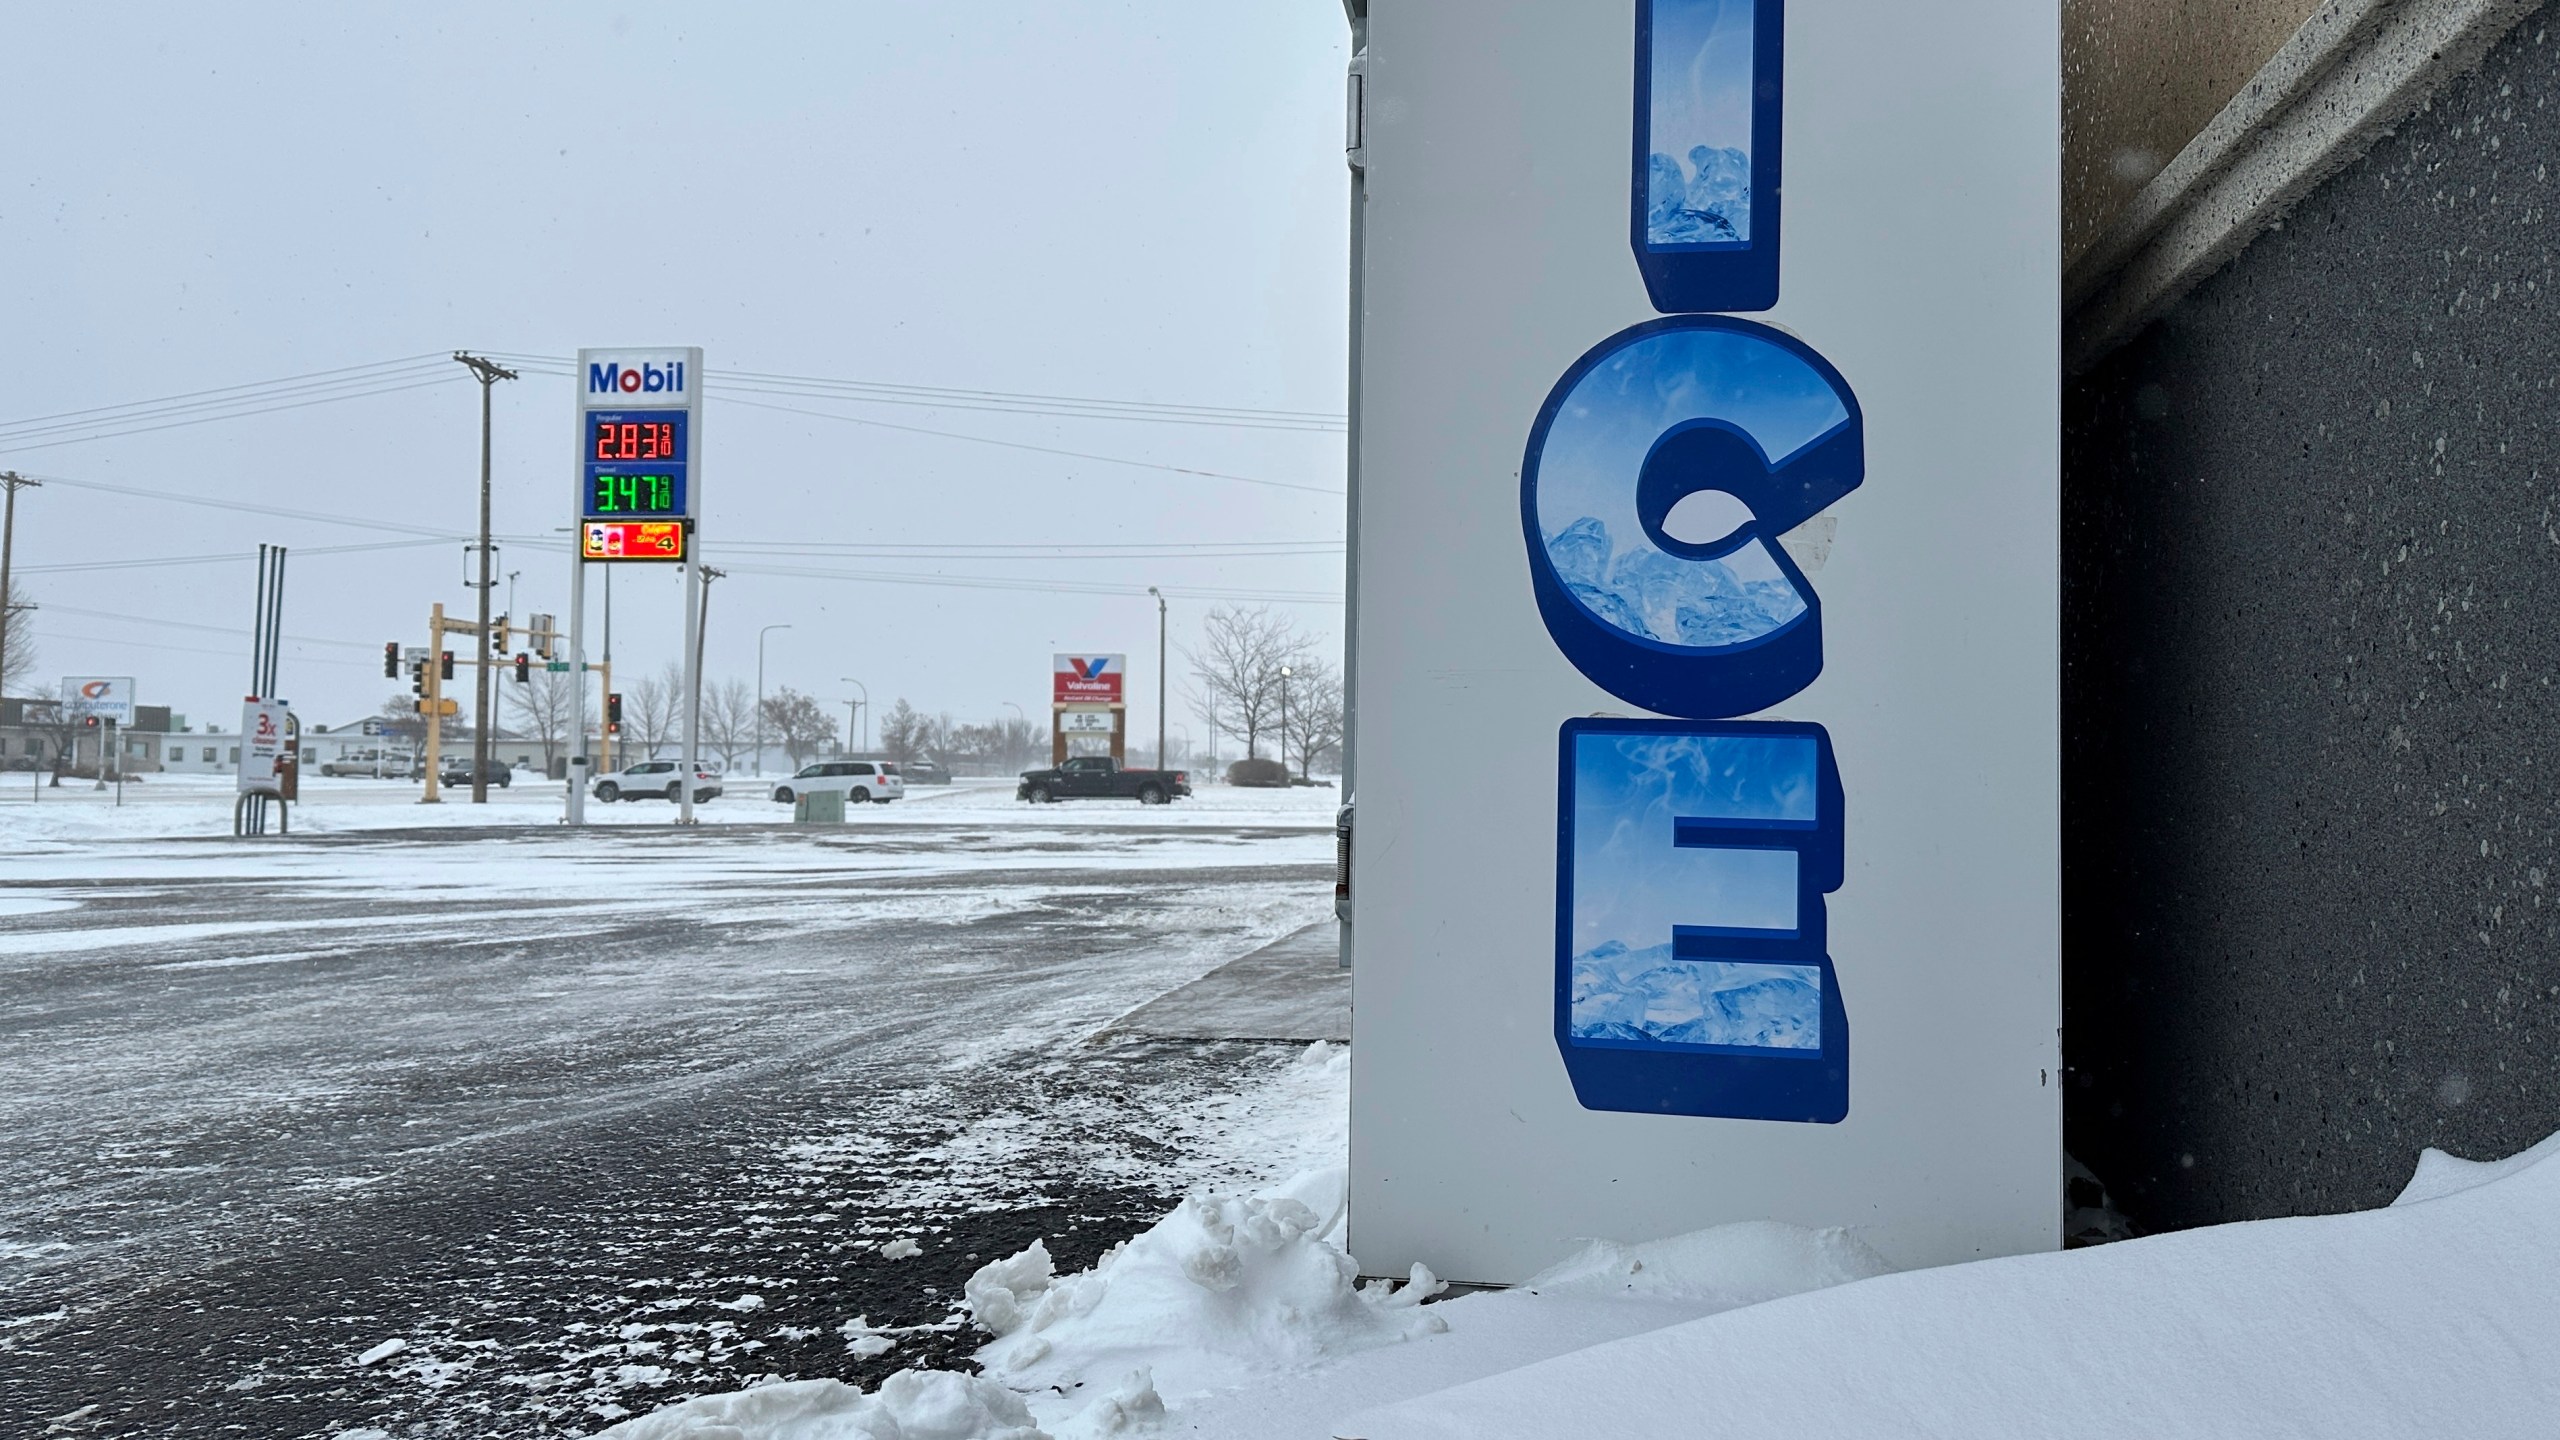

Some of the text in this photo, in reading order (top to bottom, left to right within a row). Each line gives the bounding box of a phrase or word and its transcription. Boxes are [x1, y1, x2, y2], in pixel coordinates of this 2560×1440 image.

[589, 362, 683, 393] Mobil
[656, 537, 675, 551] 4
[1520, 0, 1865, 1124] ICE
[1066, 681, 1111, 691] Valvoline
[256, 713, 277, 736] 3x
